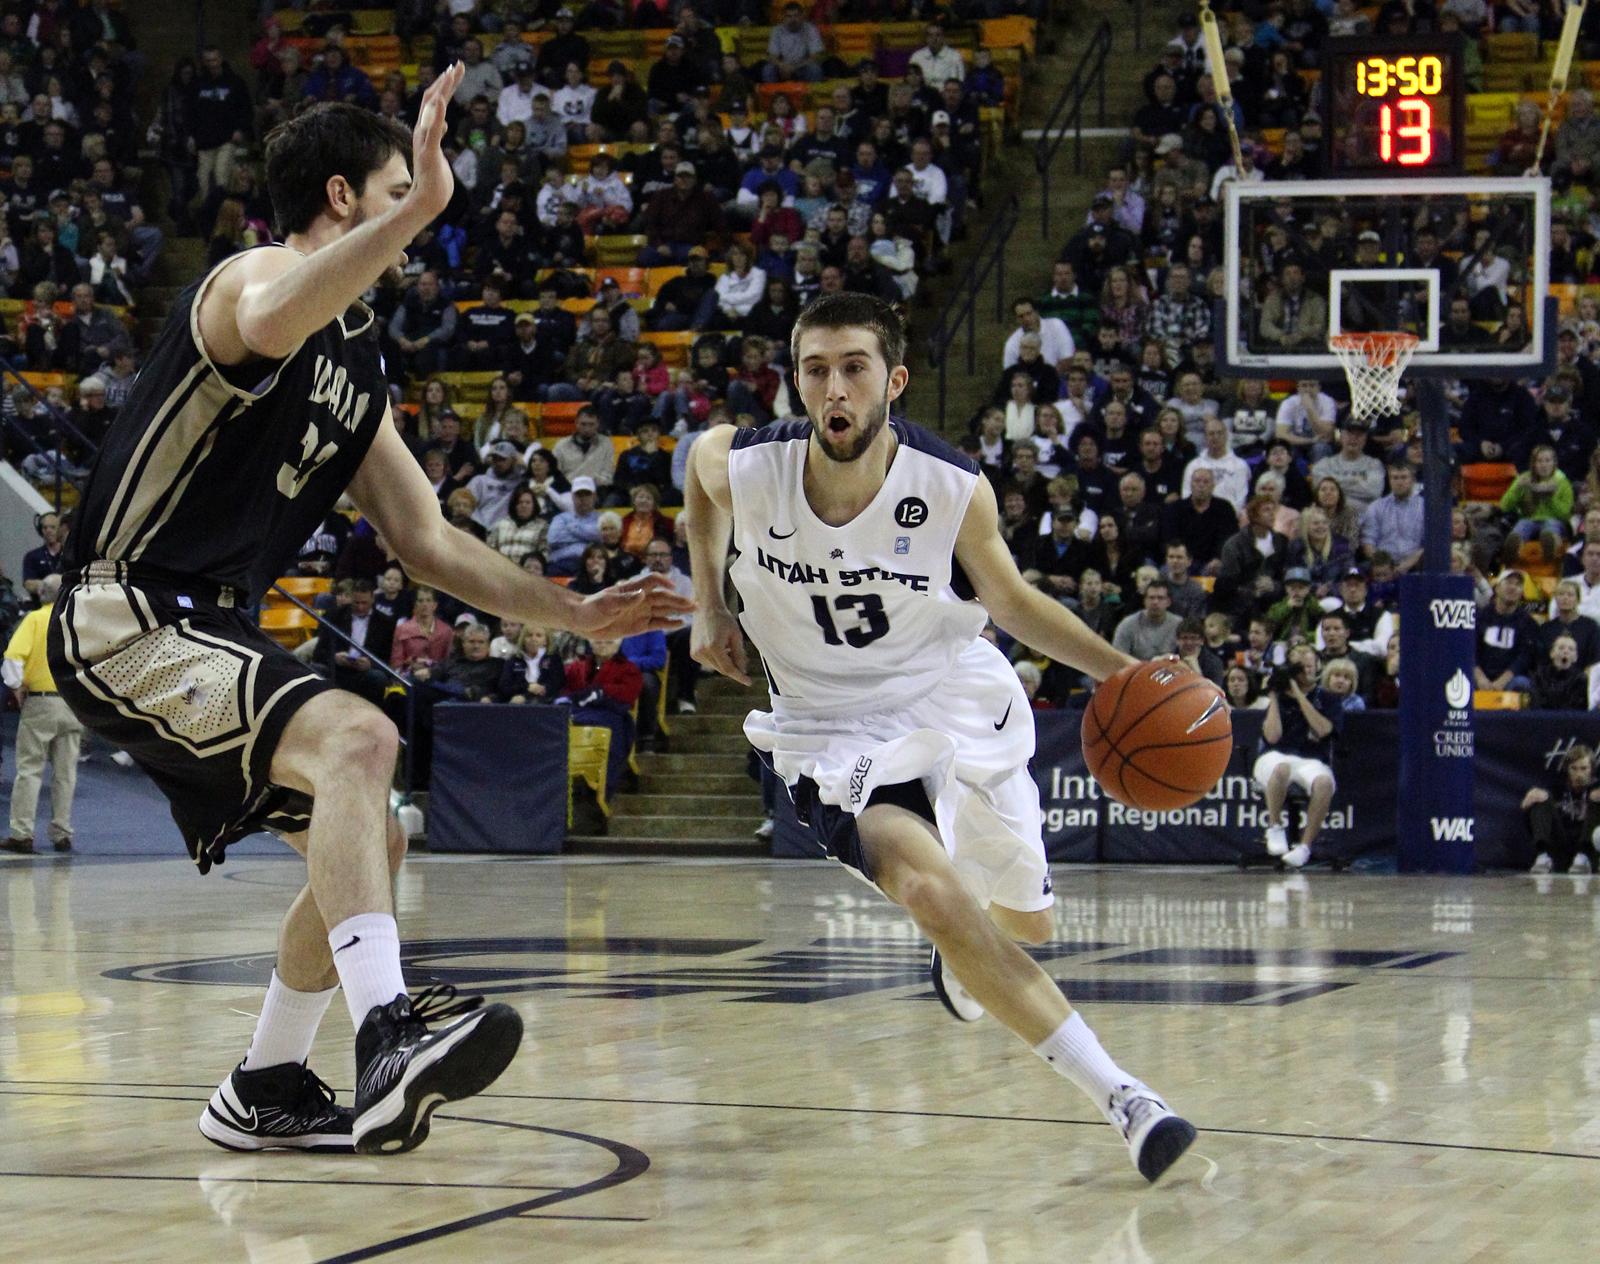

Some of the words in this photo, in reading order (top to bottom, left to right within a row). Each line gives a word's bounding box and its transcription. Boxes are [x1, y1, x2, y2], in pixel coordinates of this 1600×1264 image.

[1357, 56, 1441, 97] 13:50
[1379, 99, 1432, 165] 13
[900, 503, 923, 524] 12
[757, 546, 829, 585] UTAH
[811, 593, 890, 649] 13
[850, 755, 873, 805] WAC
[1108, 801, 1228, 832] Regional
